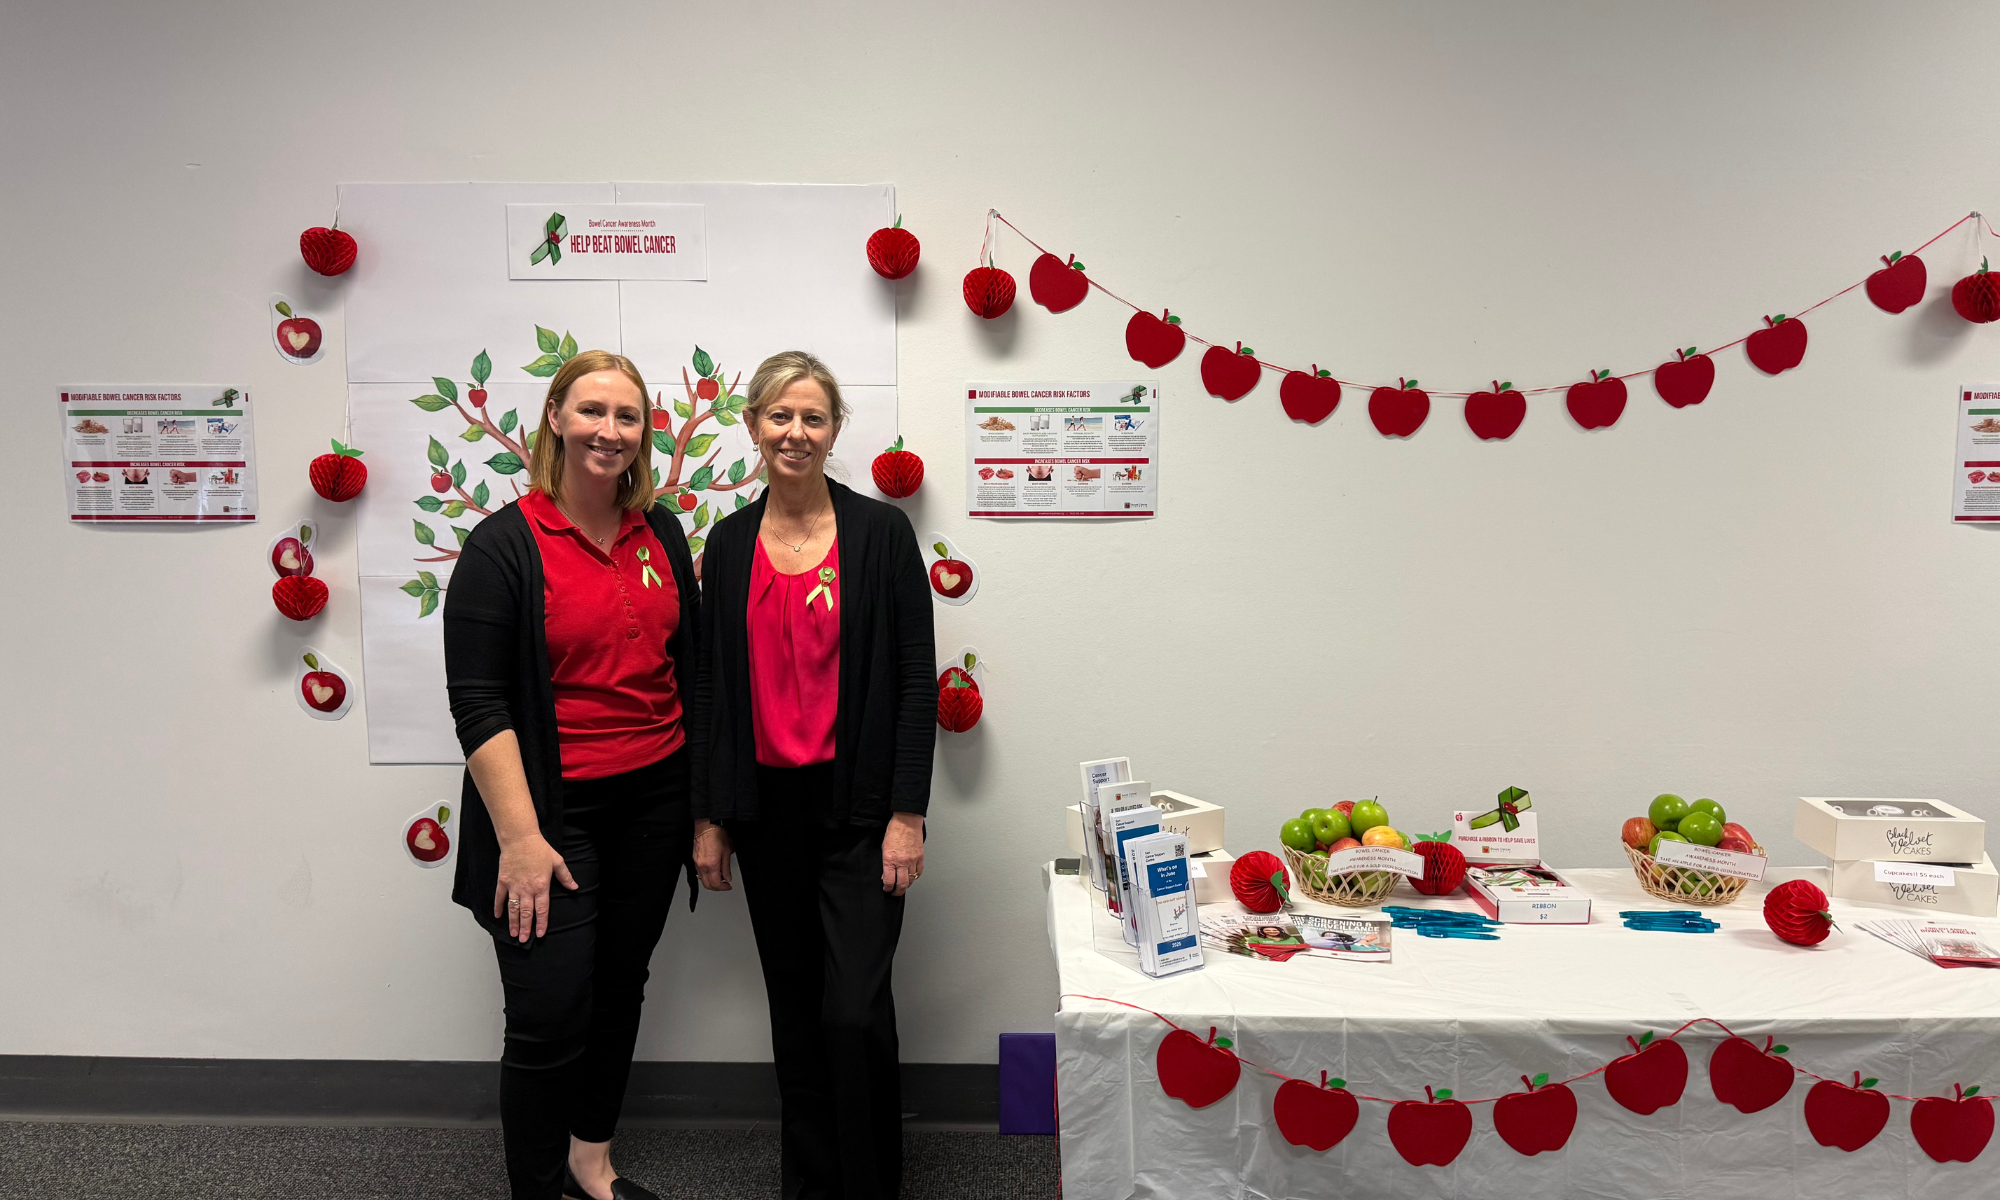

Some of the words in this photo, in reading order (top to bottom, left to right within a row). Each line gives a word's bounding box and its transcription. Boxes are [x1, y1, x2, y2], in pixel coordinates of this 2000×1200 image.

[588, 220, 602, 228] Bowel
[602, 220, 617, 228] Cancer
[618, 220, 641, 228] Awareness
[642, 220, 656, 228] Month
[571, 235, 590, 253] HELP
[593, 235, 613, 253] BEAT
[614, 235, 642, 253] BOWEL
[644, 235, 676, 253] CANCER
[70, 393, 102, 401] MODIFIABLE
[103, 393, 121, 401] BOWEL
[122, 393, 143, 401] CANCER
[144, 393, 157, 401] RISK
[158, 393, 181, 401] FACTORS
[979, 390, 1010, 398] MODIFIABLE
[1012, 390, 1030, 398] BOWEL
[1031, 390, 1052, 398] CANCER
[1052, 390, 1066, 398] RISK
[1066, 390, 1091, 398] FACTORS
[1886, 827, 1909, 842] Black
[1891, 831, 1934, 854] Velvet
[1903, 847, 1931, 855] CAKES
[1685, 853, 1716, 864] AWARENESS
[1717, 858, 1736, 867] MONTH
[1395, 866, 1419, 876] DONATION
[1733, 870, 1759, 878] DONATION
[1907, 894, 1937, 904] CAKES
[1308, 917, 1363, 926] SCREENING
[1308, 922, 1380, 932] SURVEILLANCE
